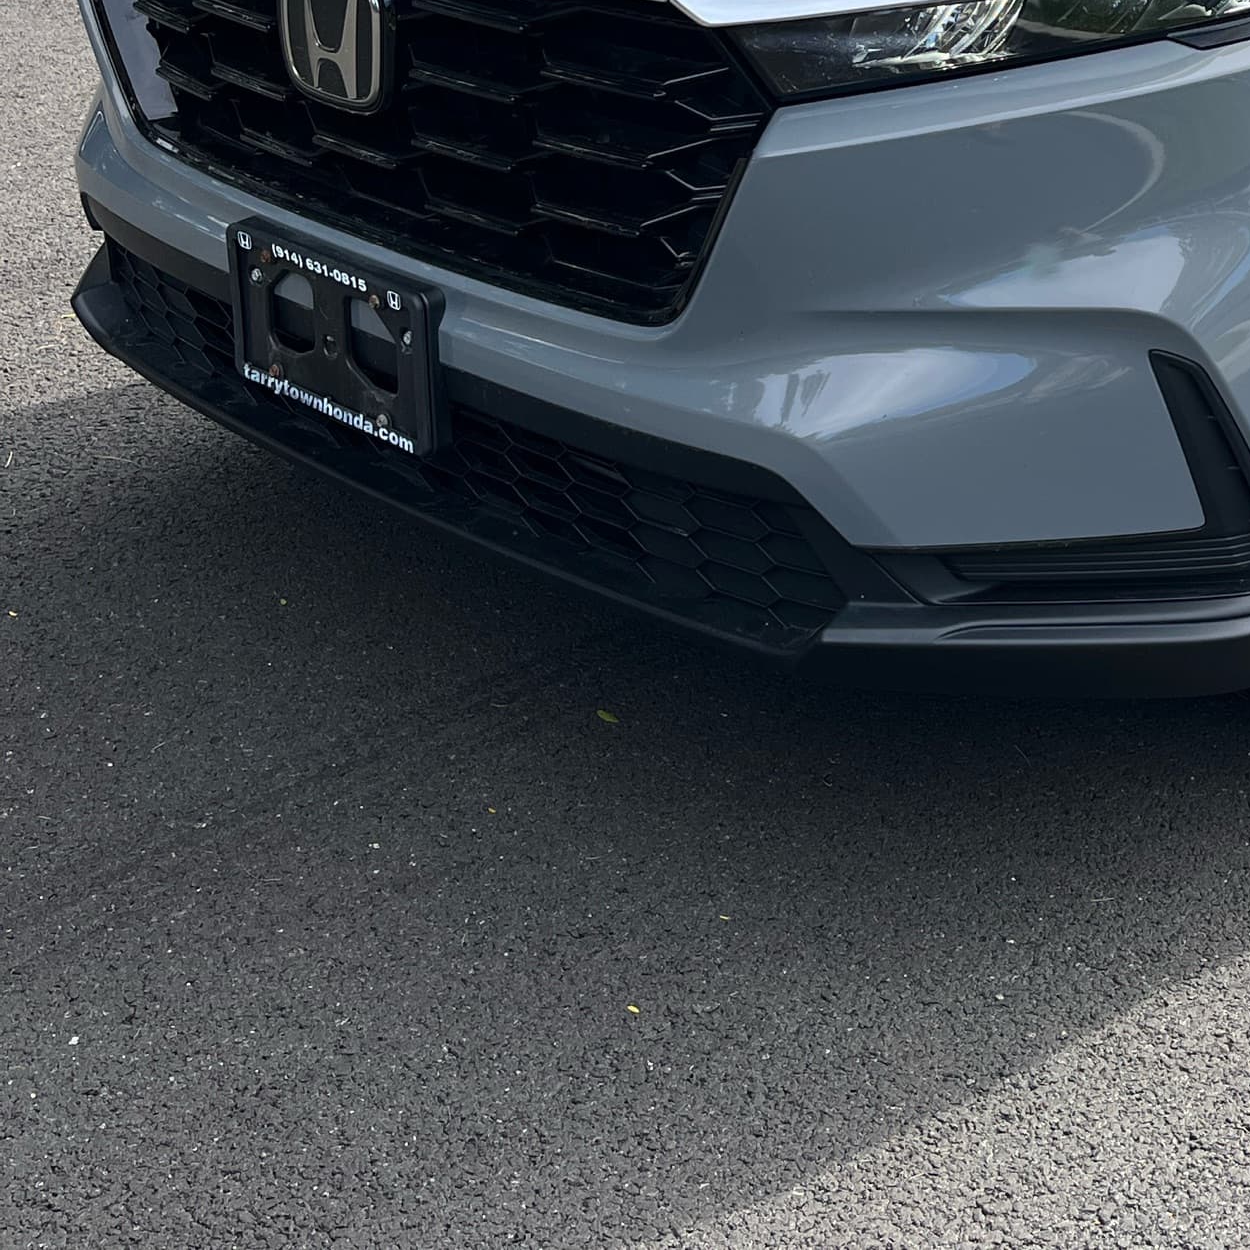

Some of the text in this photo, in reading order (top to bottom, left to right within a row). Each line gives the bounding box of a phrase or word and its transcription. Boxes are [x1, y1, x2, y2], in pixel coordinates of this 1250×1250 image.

[271, 243, 367, 292] (914) 631-0815
[243, 363, 415, 454] tarrytownhonda.com
